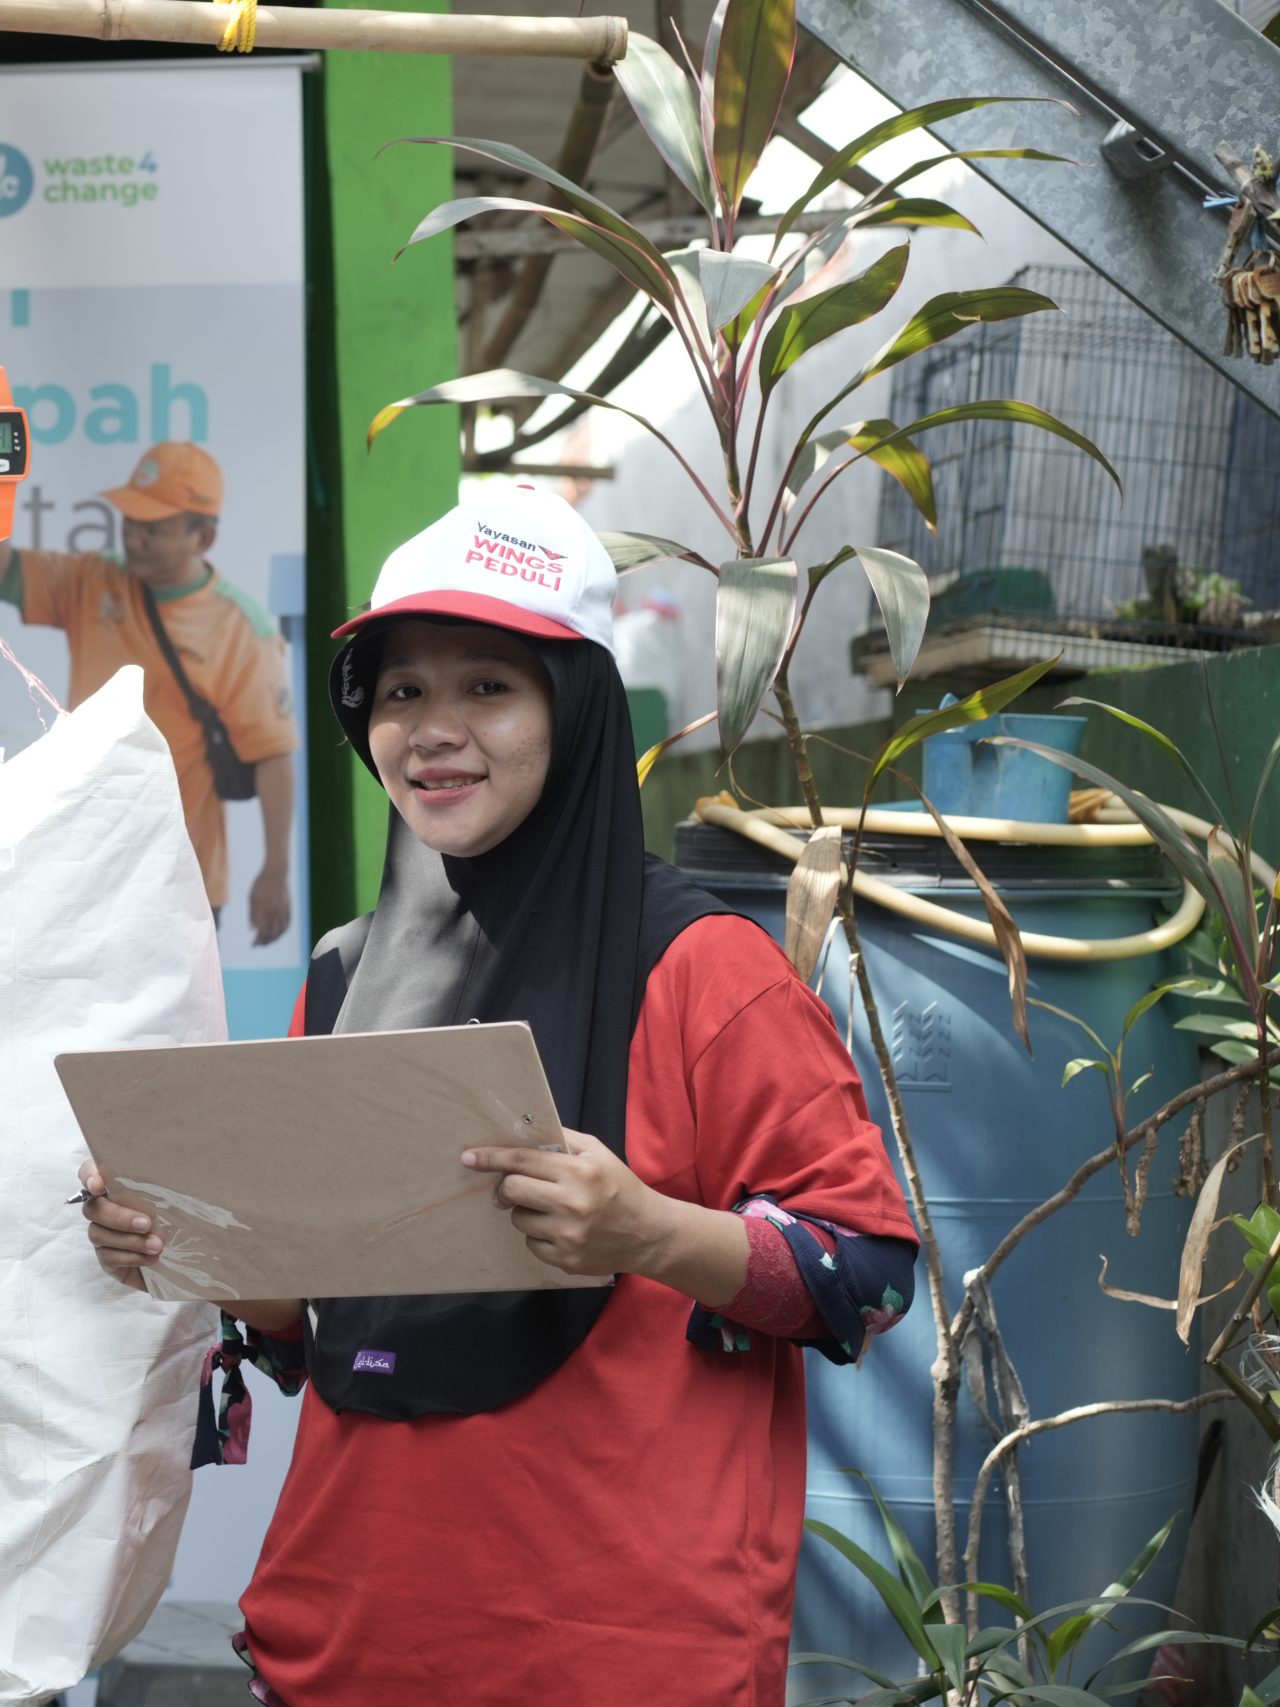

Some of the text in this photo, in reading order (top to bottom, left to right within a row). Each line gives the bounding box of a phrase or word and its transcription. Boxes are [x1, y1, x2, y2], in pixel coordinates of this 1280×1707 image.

[43, 179, 159, 207] change
[473, 534, 564, 574] WINGS
[477, 521, 537, 552] Yayasan
[464, 549, 562, 592] PEDULI
